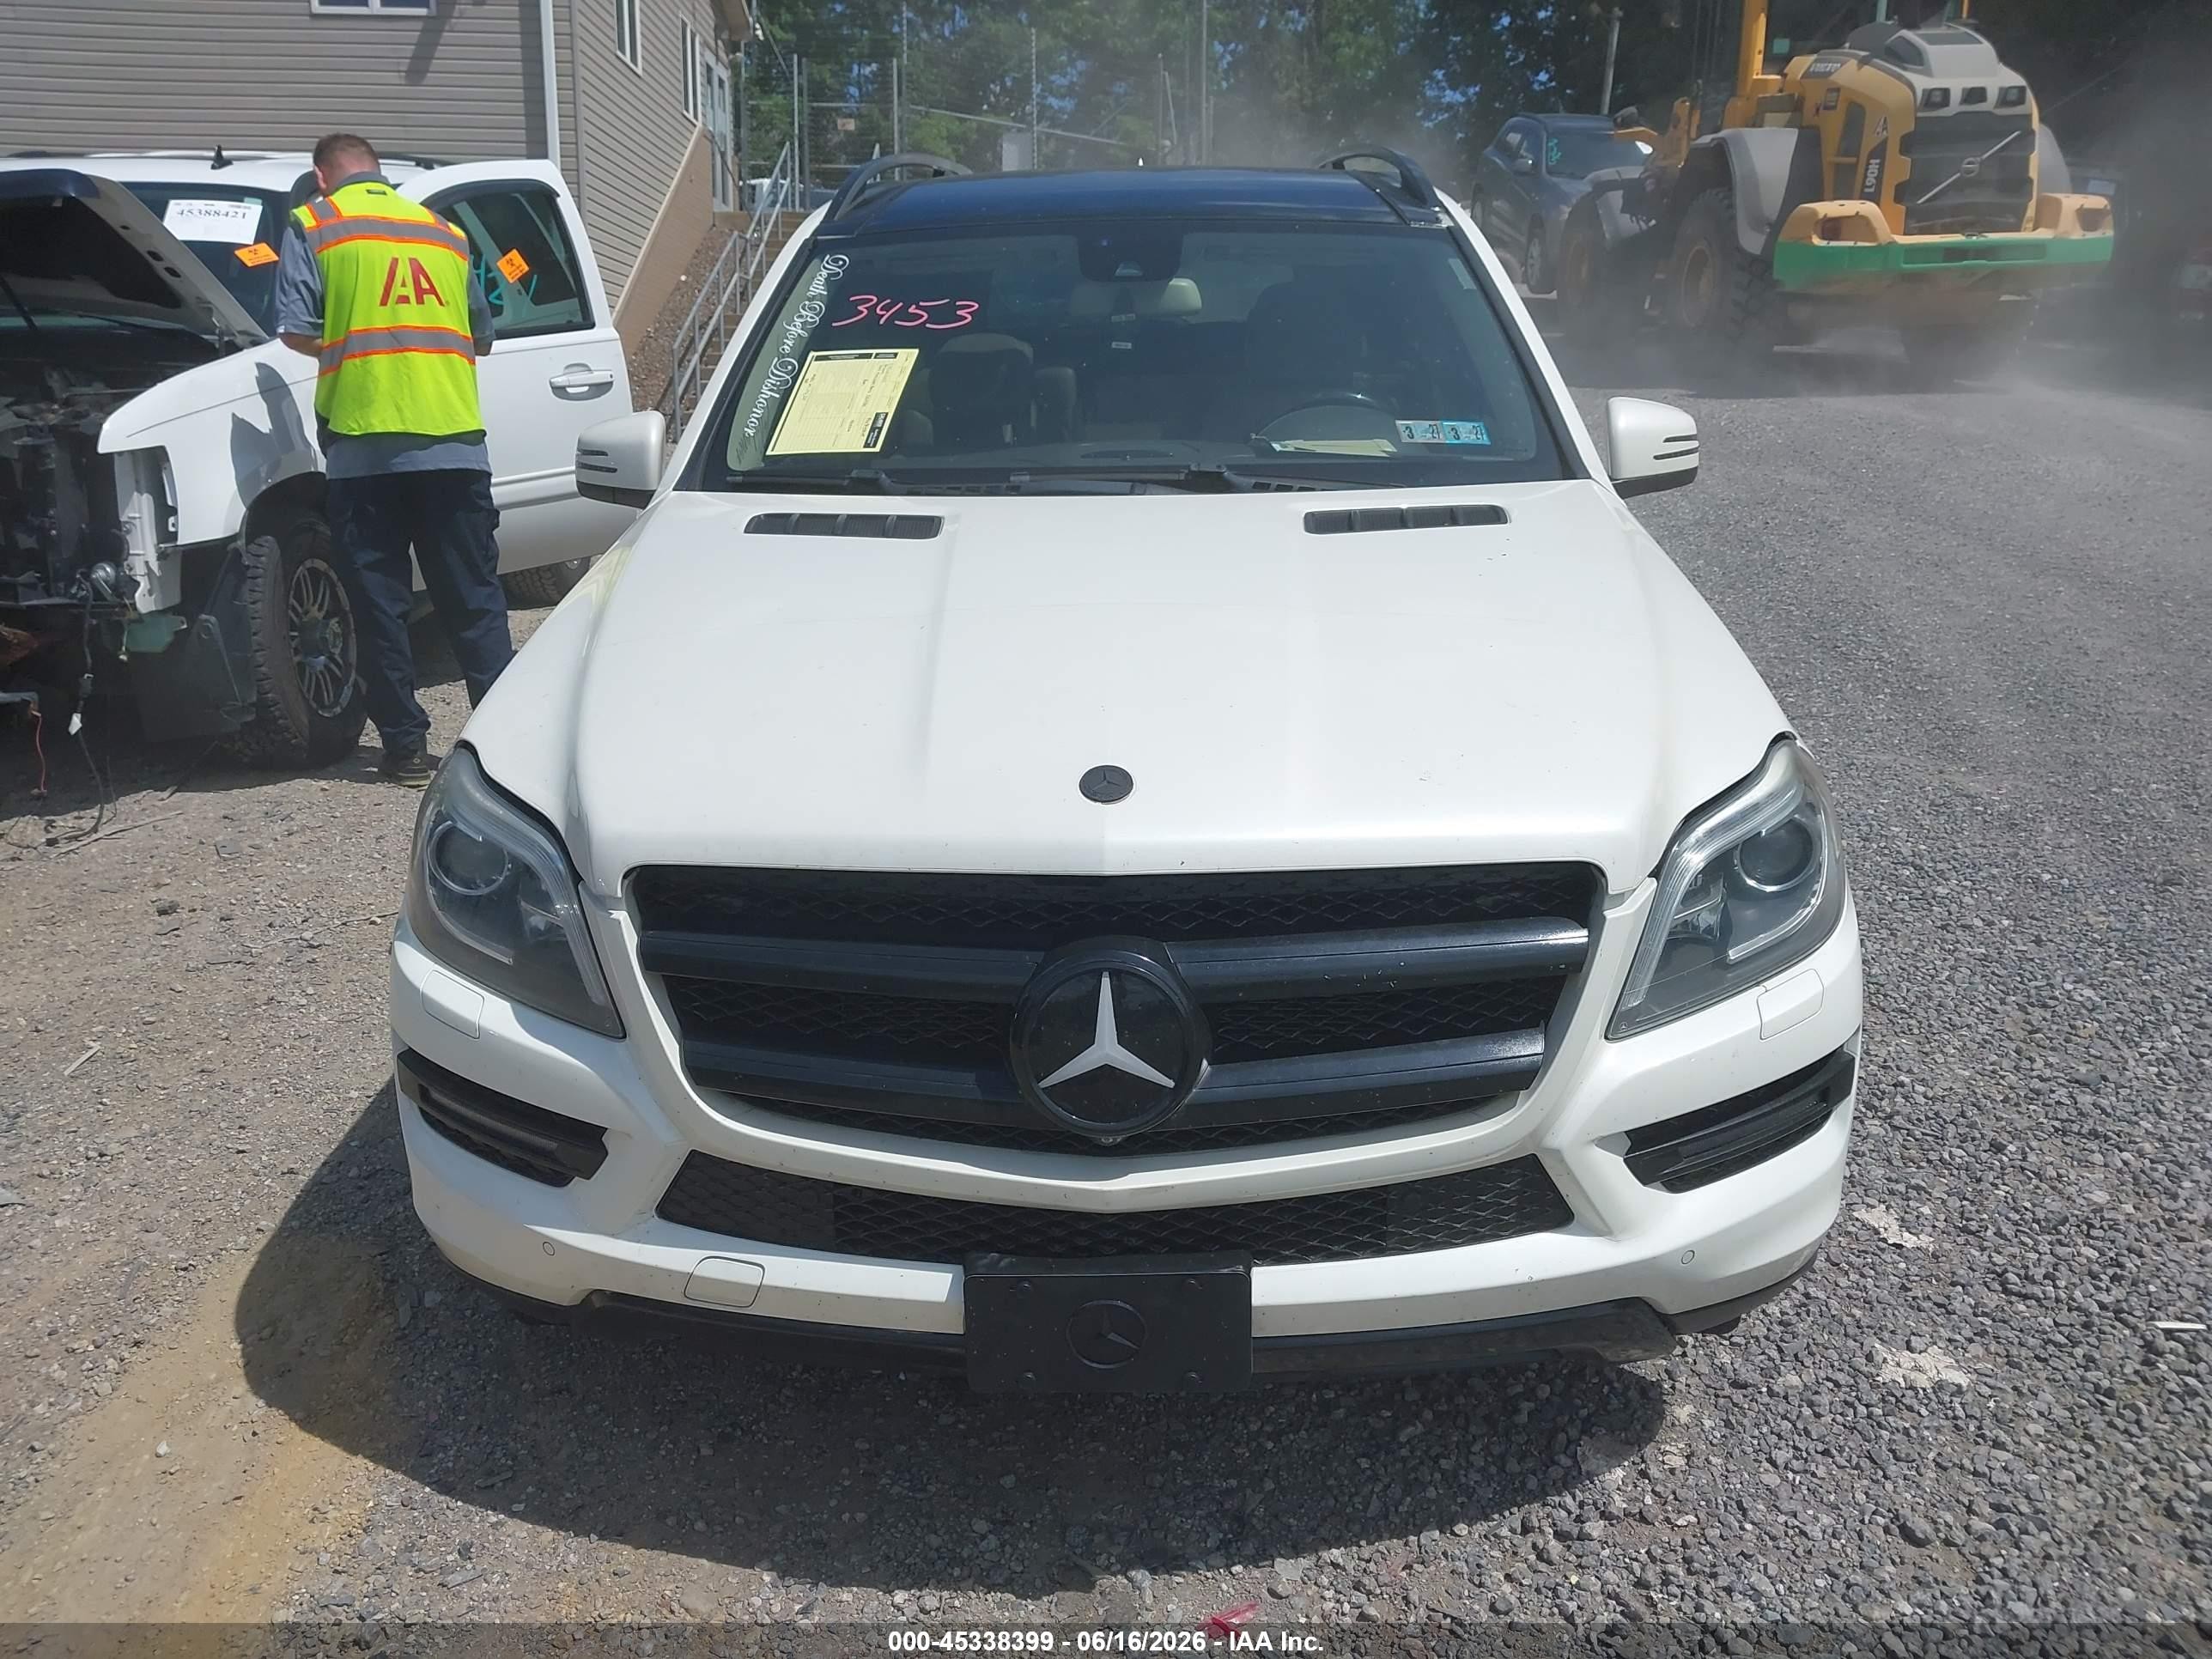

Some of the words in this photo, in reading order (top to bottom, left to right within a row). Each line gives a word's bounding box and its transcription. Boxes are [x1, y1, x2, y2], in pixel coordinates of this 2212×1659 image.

[1863, 158, 1881, 193] L90H
[807, 253, 850, 298] Death
[779, 301, 825, 354] Before
[831, 294, 981, 330] 3453
[744, 356, 798, 438] Dishonor
